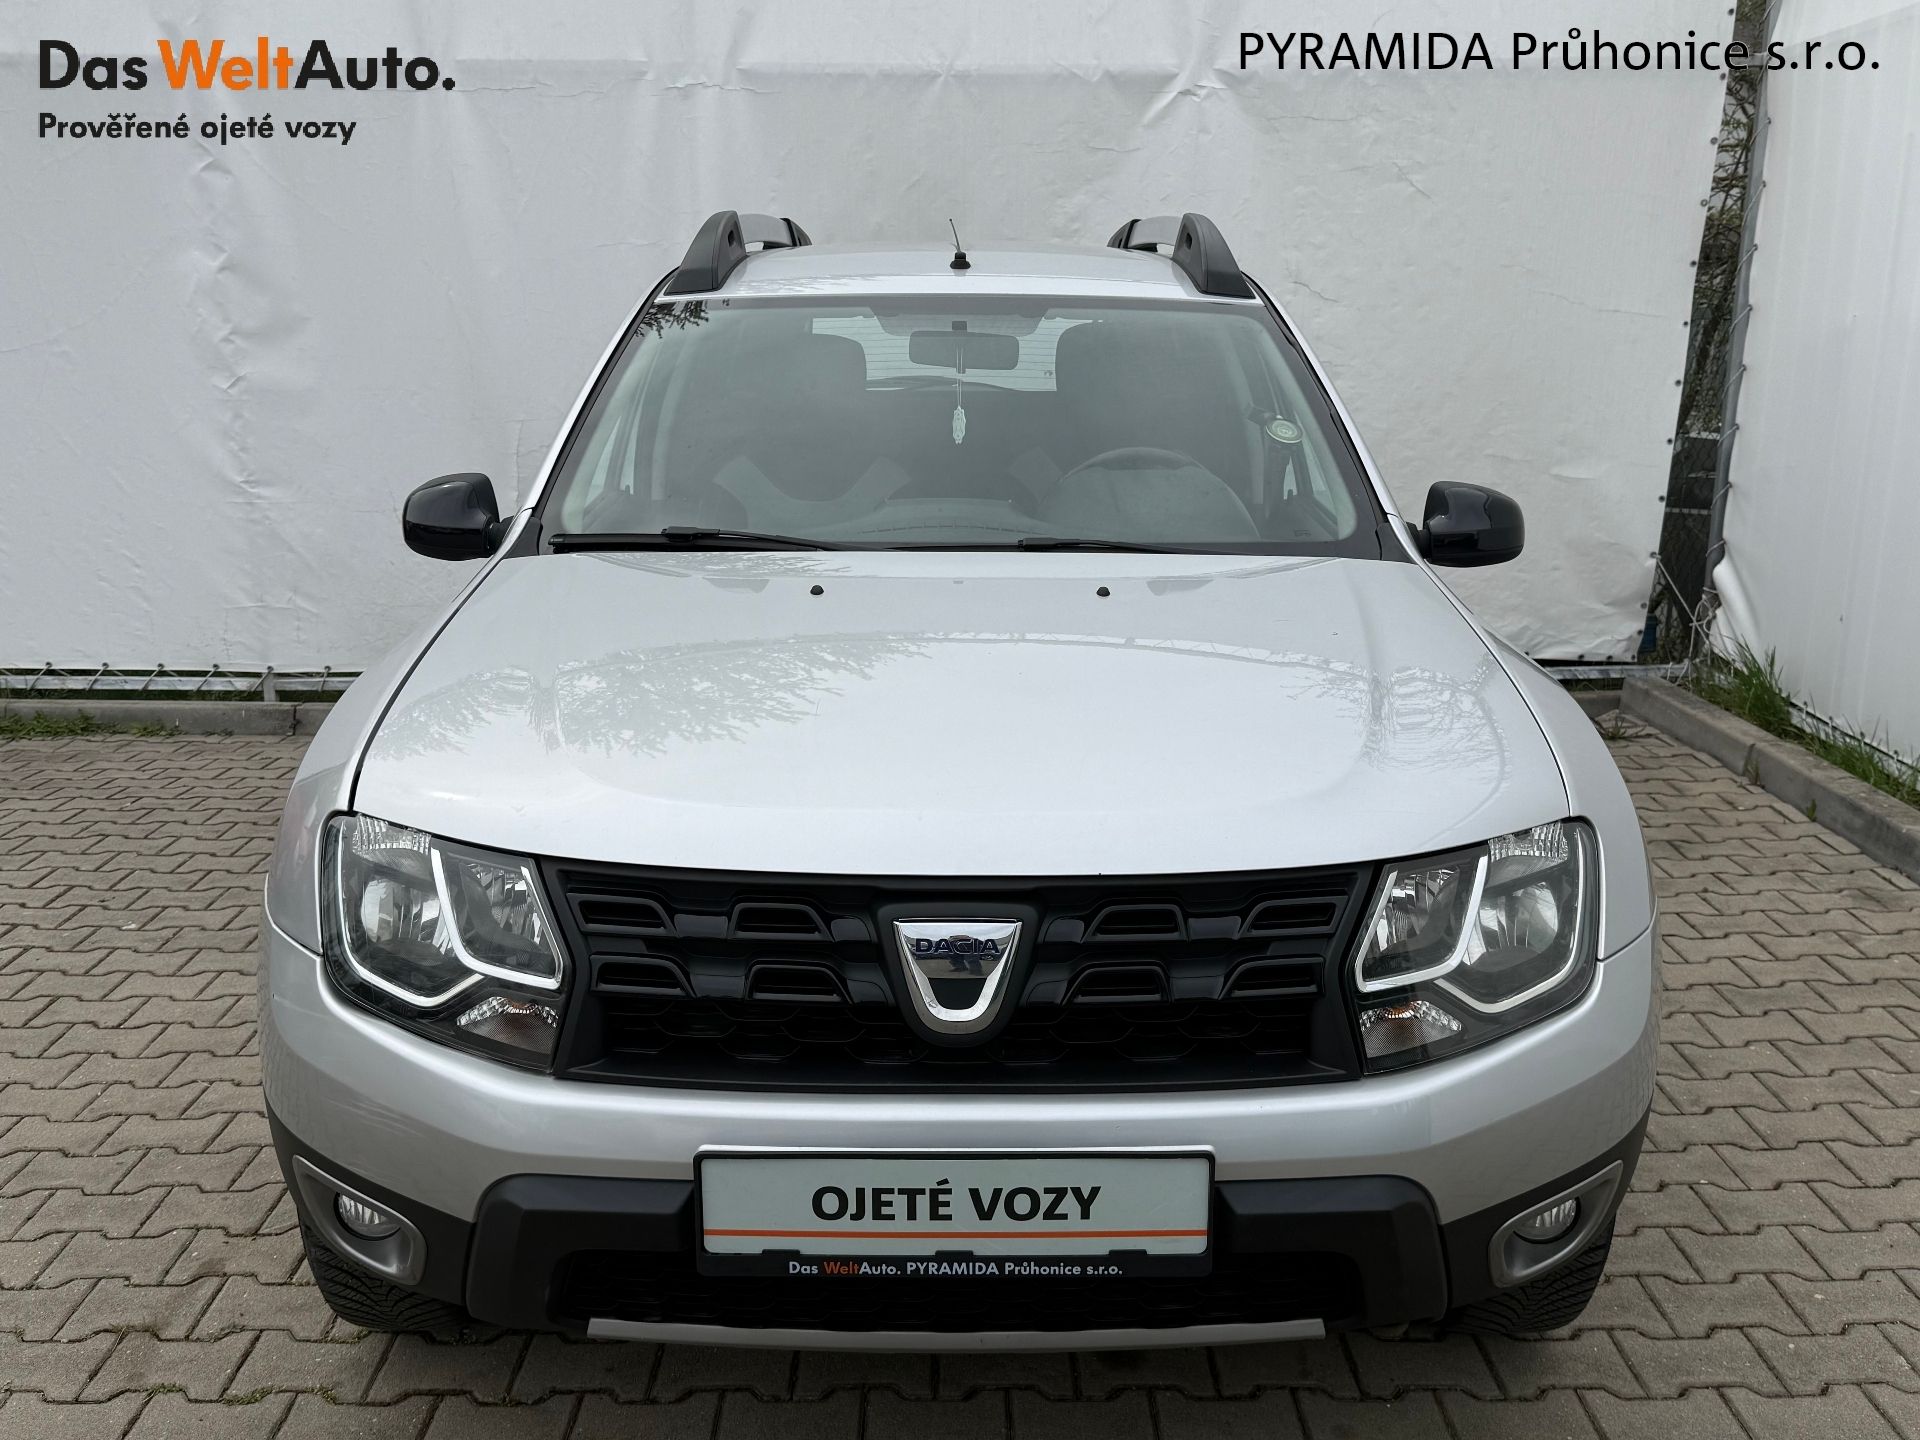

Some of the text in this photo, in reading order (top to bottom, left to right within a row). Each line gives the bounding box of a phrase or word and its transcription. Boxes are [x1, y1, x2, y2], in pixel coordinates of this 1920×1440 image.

[915, 937, 1001, 955] DACIA
[811, 1177, 1102, 1222] OJETÉ VOZY
[788, 1260, 1123, 1275] Das WeltAuto. PYRAMIDA Průhonice s.r.o.
